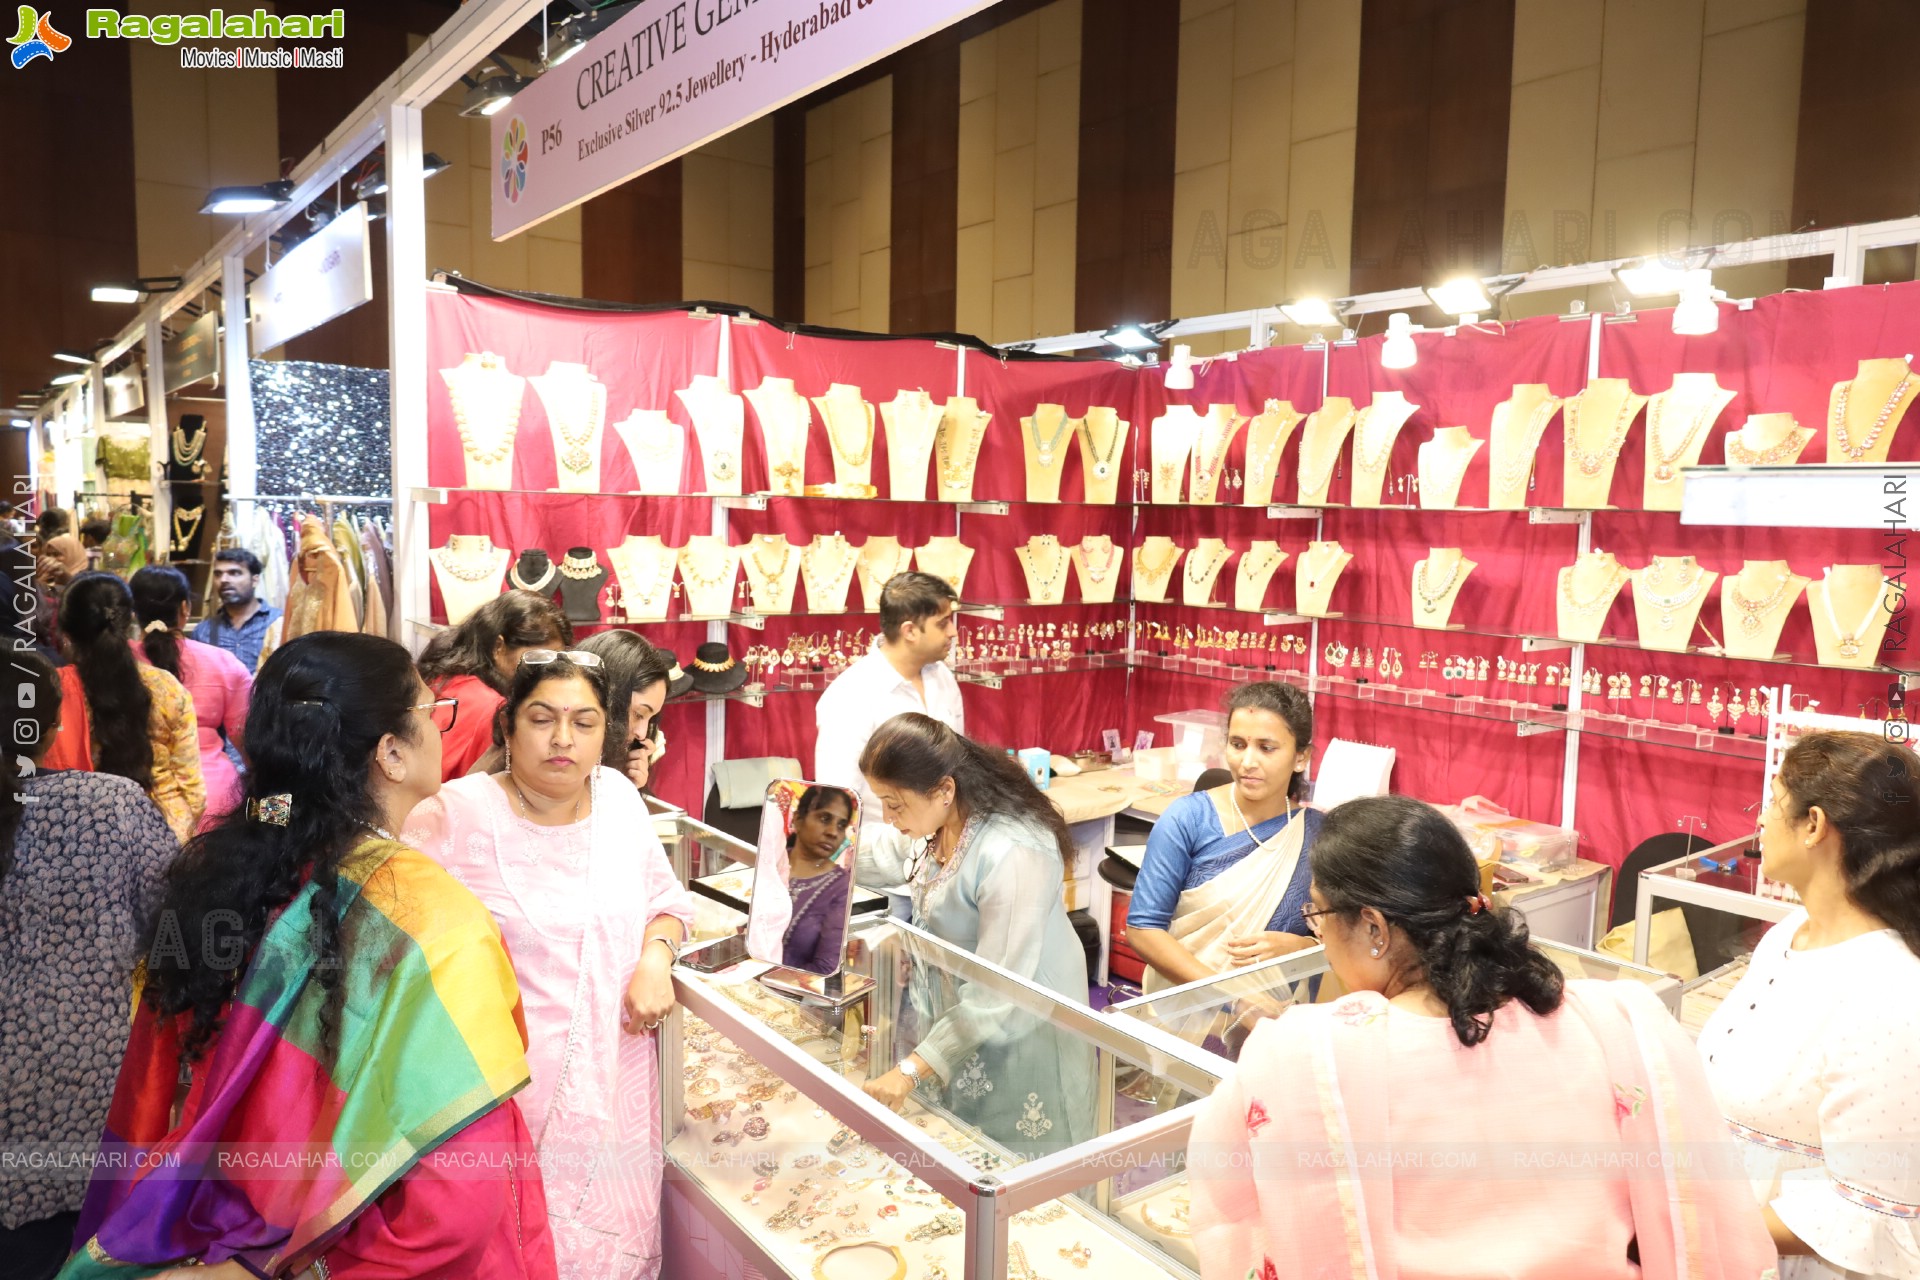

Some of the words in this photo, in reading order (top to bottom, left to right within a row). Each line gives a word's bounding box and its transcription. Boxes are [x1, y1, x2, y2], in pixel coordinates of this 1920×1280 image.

[576, 2, 687, 110] CREATIVE
[577, 123, 622, 161] Exclusive
[625, 103, 656, 136] Silver
[659, 82, 683, 119] 92.5
[685, 54, 748, 104] Jewellery
[760, 0, 851, 64] Hyderabad
[541, 119, 563, 155] P56
